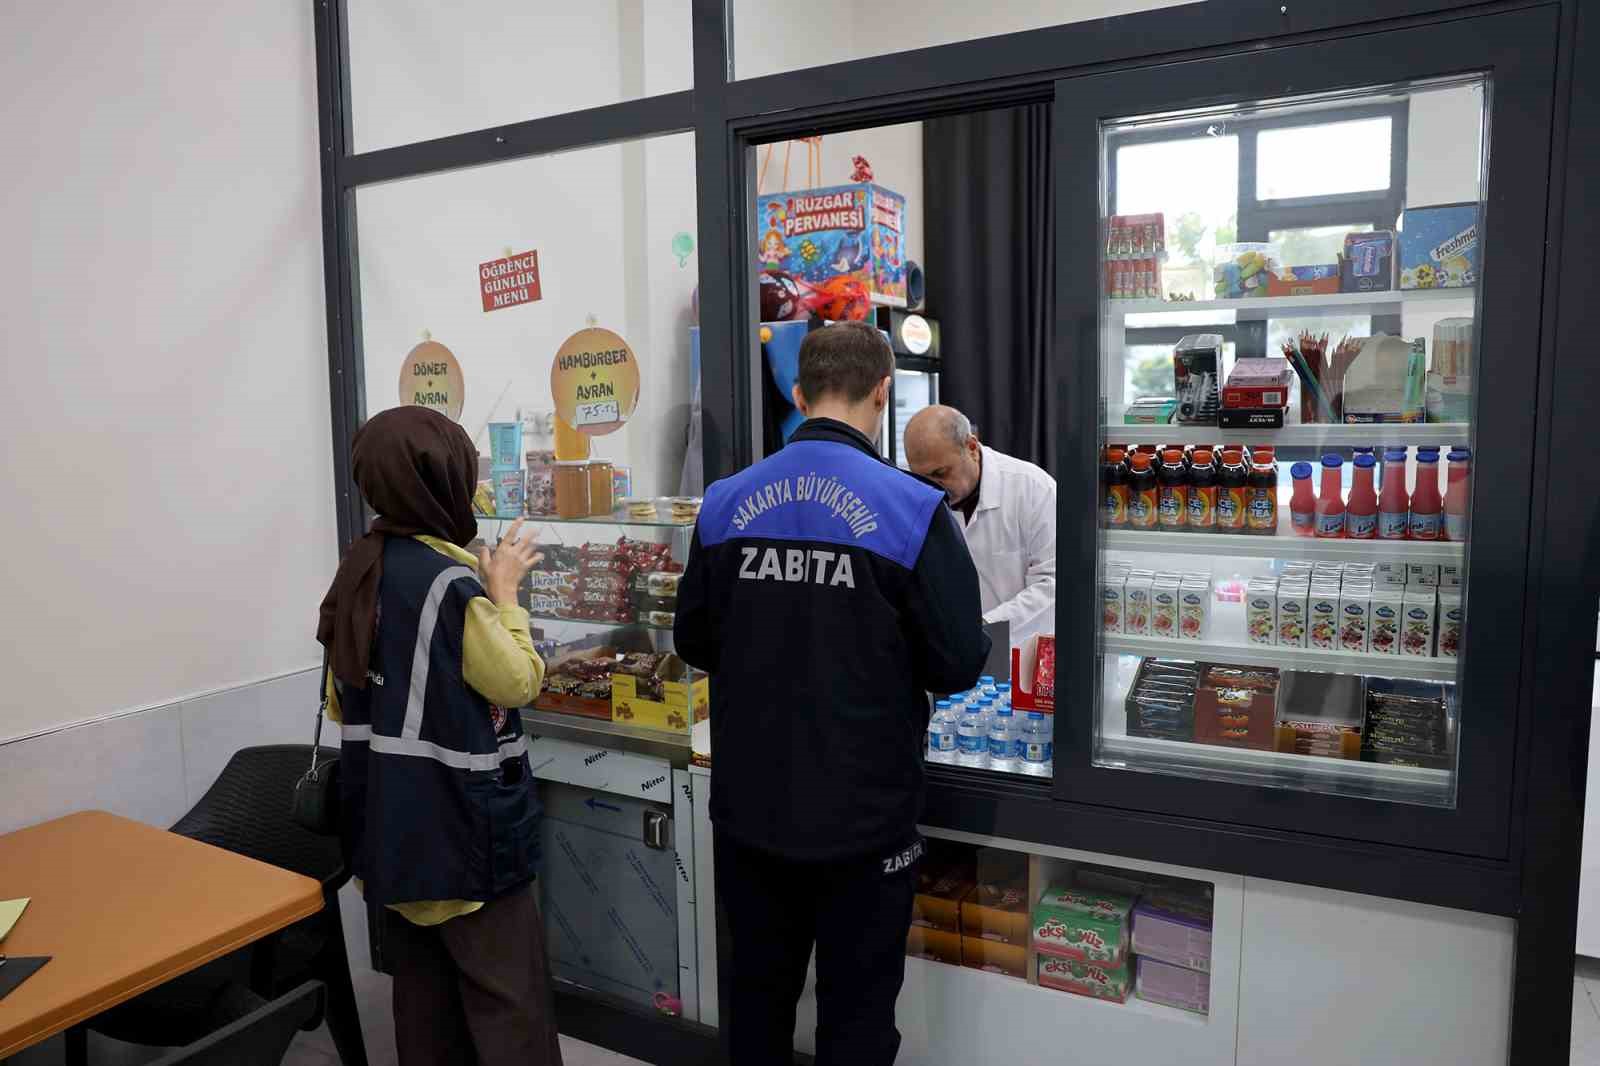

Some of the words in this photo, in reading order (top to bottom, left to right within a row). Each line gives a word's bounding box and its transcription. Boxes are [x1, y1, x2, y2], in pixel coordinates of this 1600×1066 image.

[484, 270, 536, 294] GÜNLÜK
[494, 286, 529, 307] MENÜ
[414, 361, 449, 377] DÖNER
[559, 348, 628, 371] HAMBURGER
[414, 391, 448, 406] AYRAN
[576, 381, 614, 401] AYRAN
[732, 478, 793, 531] SAKARYA
[796, 471, 878, 539] BÜYÜKŞEHİR
[739, 547, 855, 588] ZABITA
[584, 750, 608, 767] Nitto
[641, 775, 666, 792] Nitto
